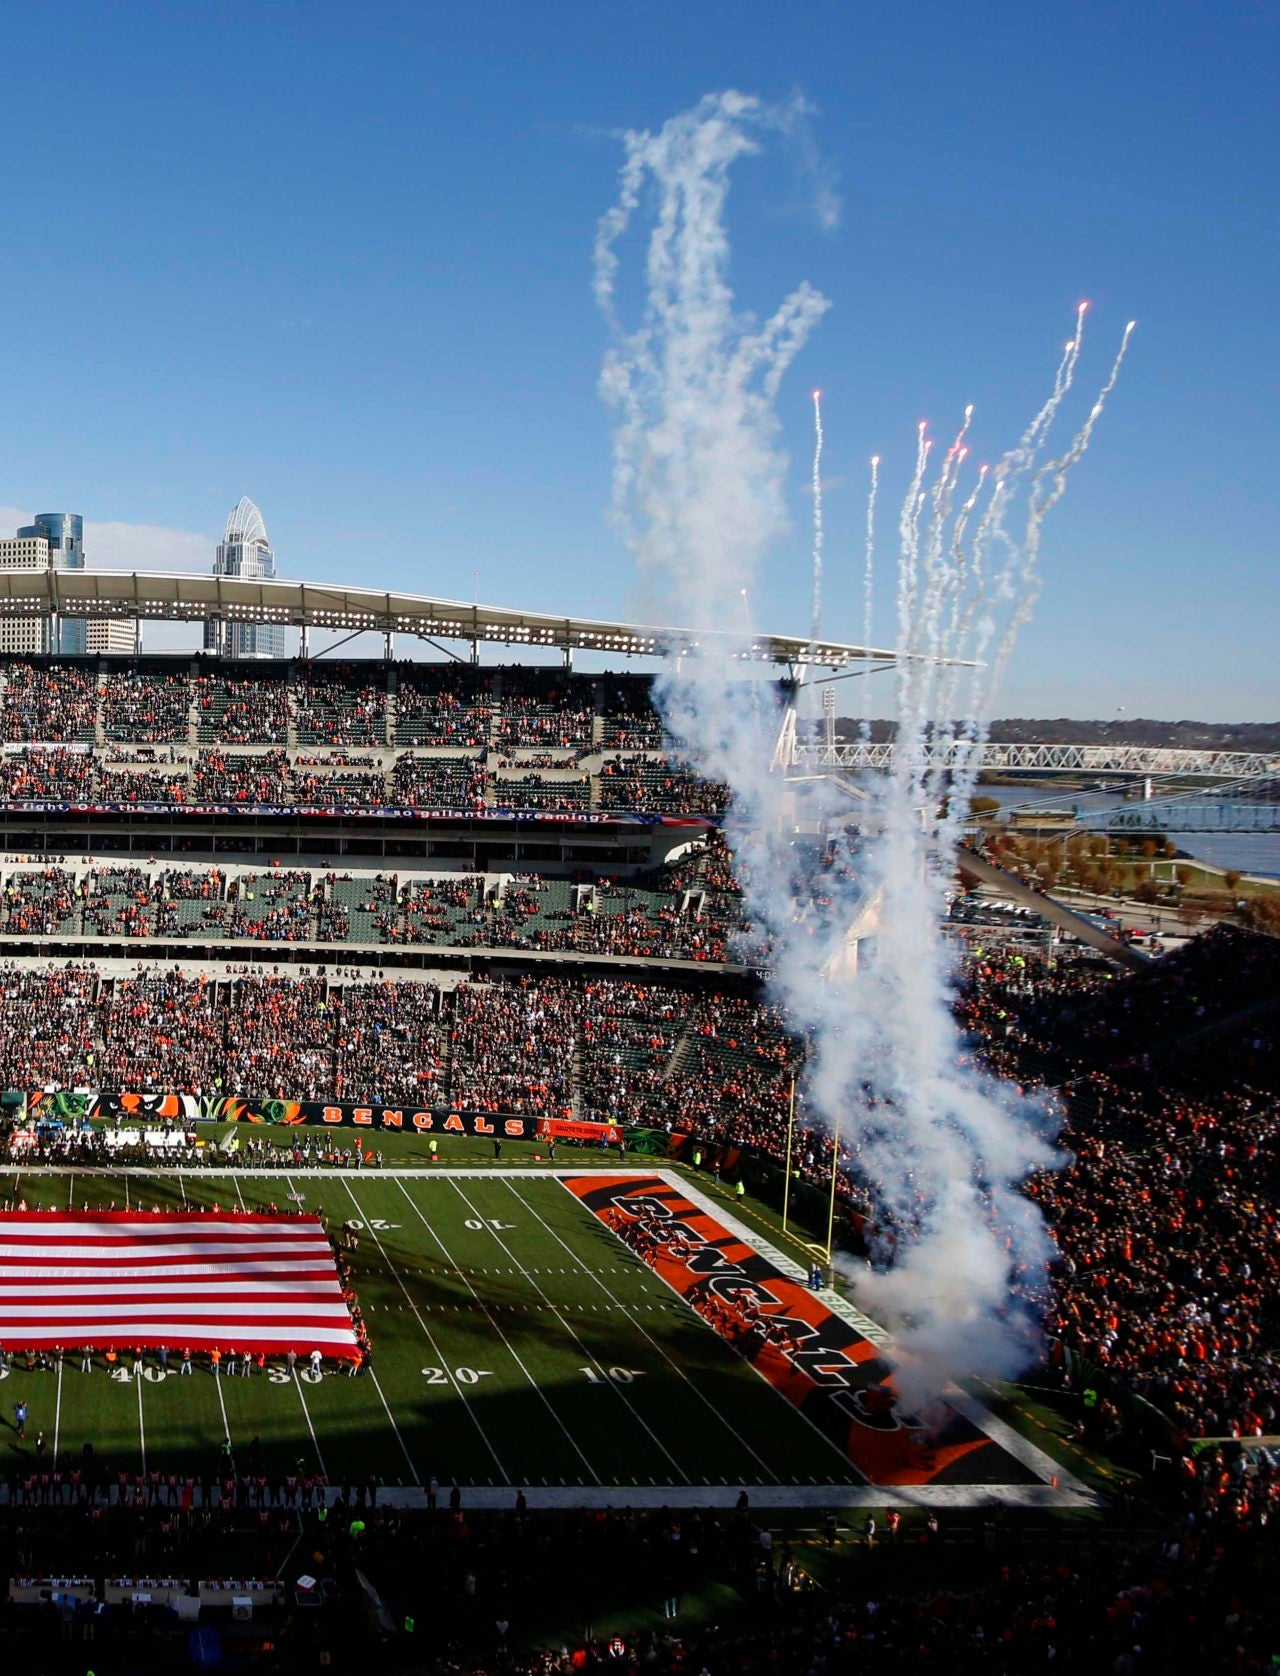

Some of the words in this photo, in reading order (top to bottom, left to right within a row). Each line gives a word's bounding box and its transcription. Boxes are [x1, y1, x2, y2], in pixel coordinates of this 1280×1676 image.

[119, 804, 145, 812] the
[153, 804, 230, 814] ramparts
[421, 808, 498, 818] gallantly
[507, 811, 608, 821] streaming?
[322, 1107, 524, 1136] BENGALS
[464, 1219, 507, 1230] 10
[745, 1237, 806, 1278] SALUTE
[611, 1196, 929, 1431] BENGALS
[111, 1366, 166, 1382] 40
[268, 1367, 323, 1383] 30
[421, 1367, 480, 1384] 20
[579, 1367, 635, 1384] 10
